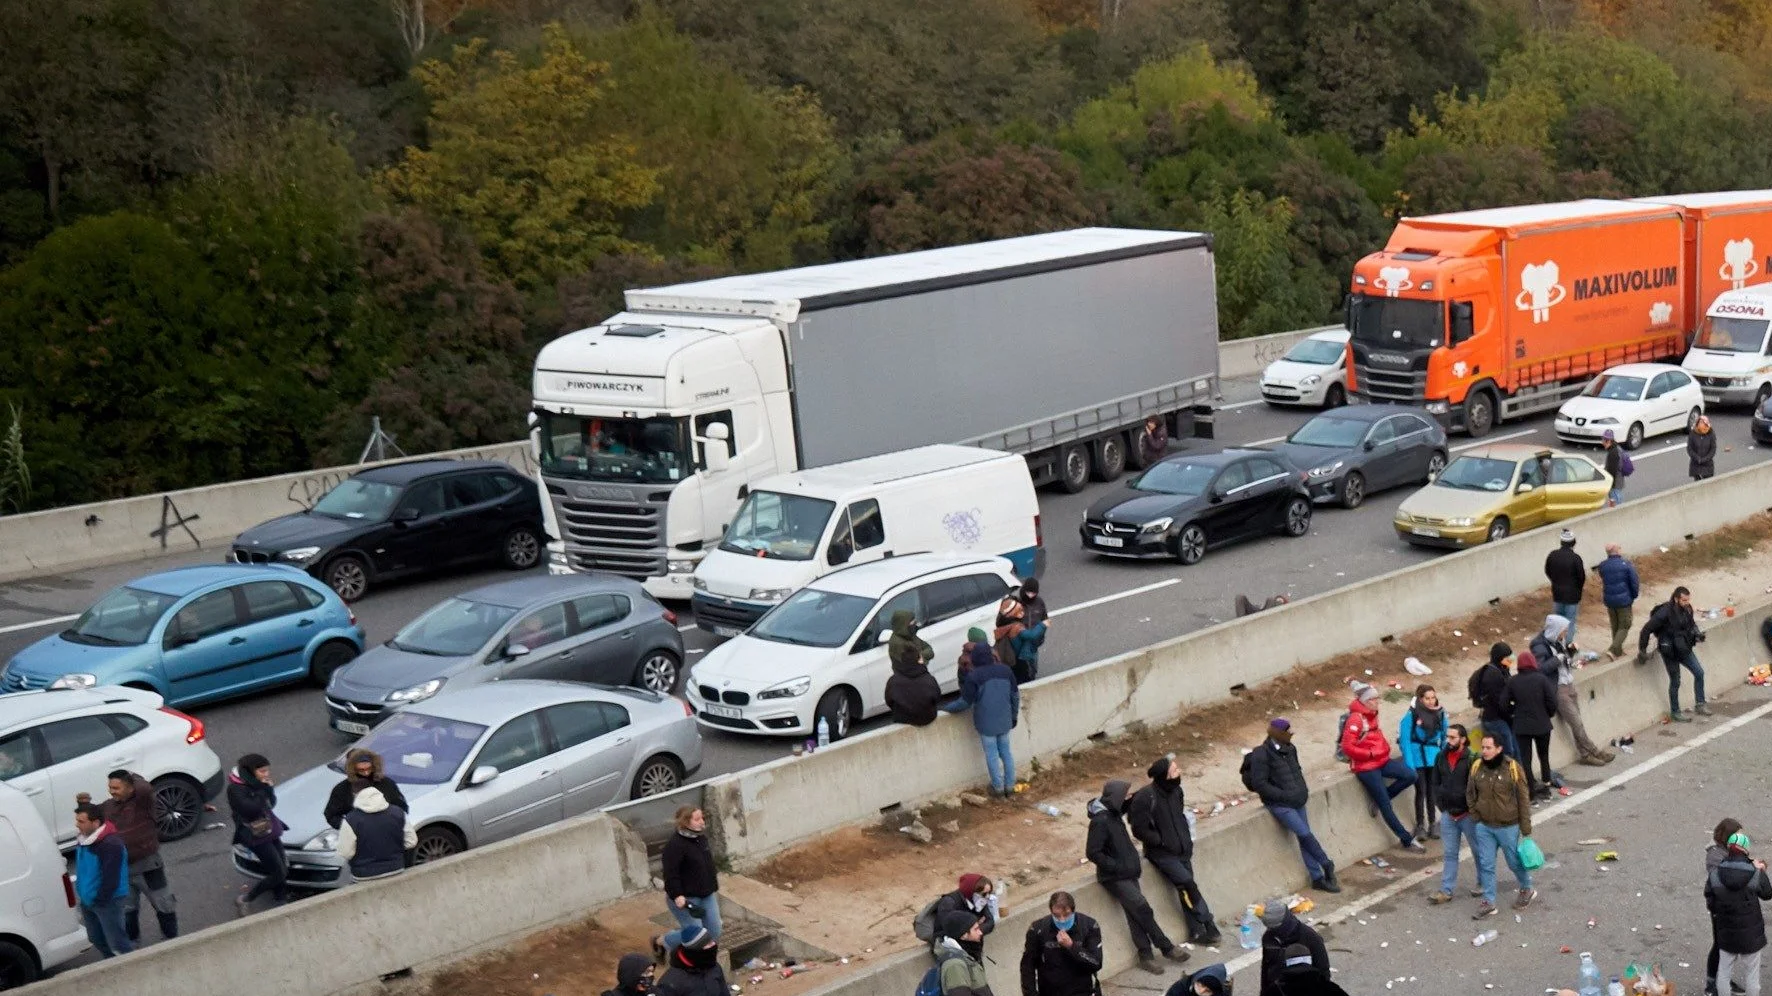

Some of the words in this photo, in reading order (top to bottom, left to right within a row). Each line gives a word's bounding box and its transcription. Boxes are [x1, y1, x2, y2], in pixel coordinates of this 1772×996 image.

[1573, 265, 1678, 301] MAXIVOLUM
[1716, 304, 1765, 316] OSONA
[566, 380, 644, 393] PIWOWARCZYK
